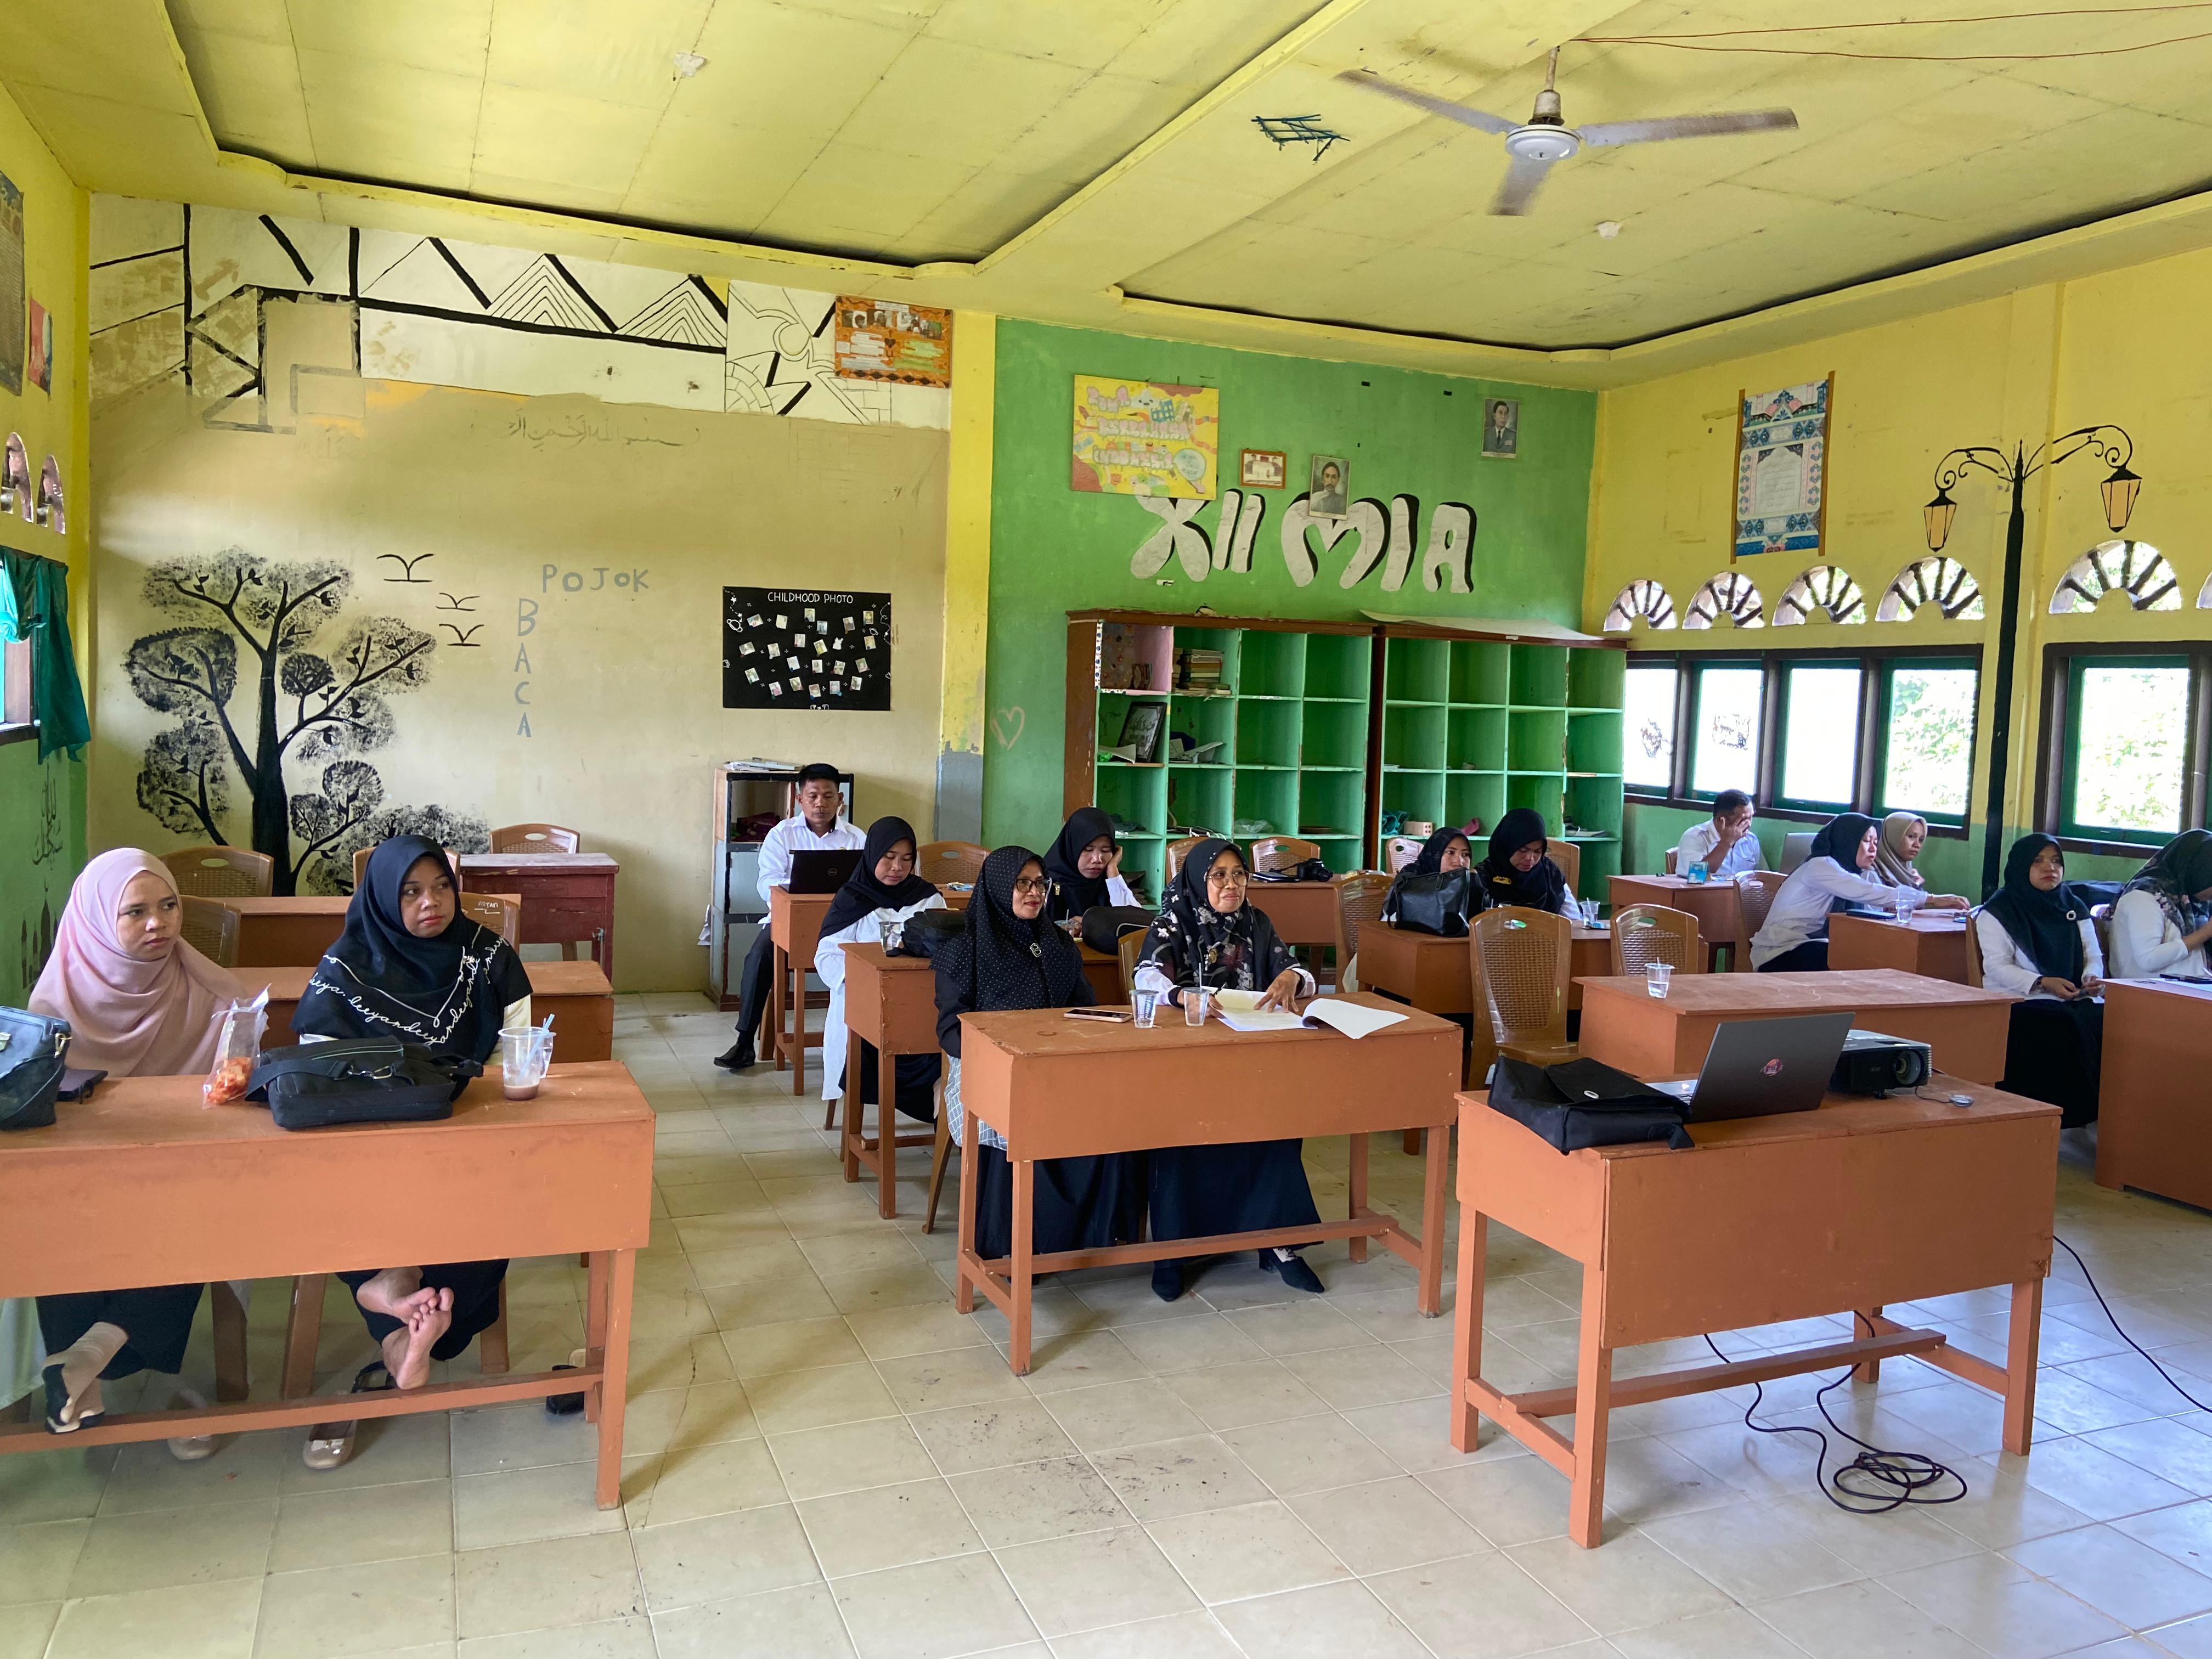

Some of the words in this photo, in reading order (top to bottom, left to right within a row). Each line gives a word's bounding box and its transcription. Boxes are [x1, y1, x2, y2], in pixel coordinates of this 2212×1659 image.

[1130, 488, 1266, 582] XII
[1280, 491, 1476, 593] MIA
[542, 563, 649, 593] POJOK
[768, 591, 821, 603] CHILDHOOD
[823, 593, 854, 604] PHOTO
[514, 598, 539, 737] BACA
